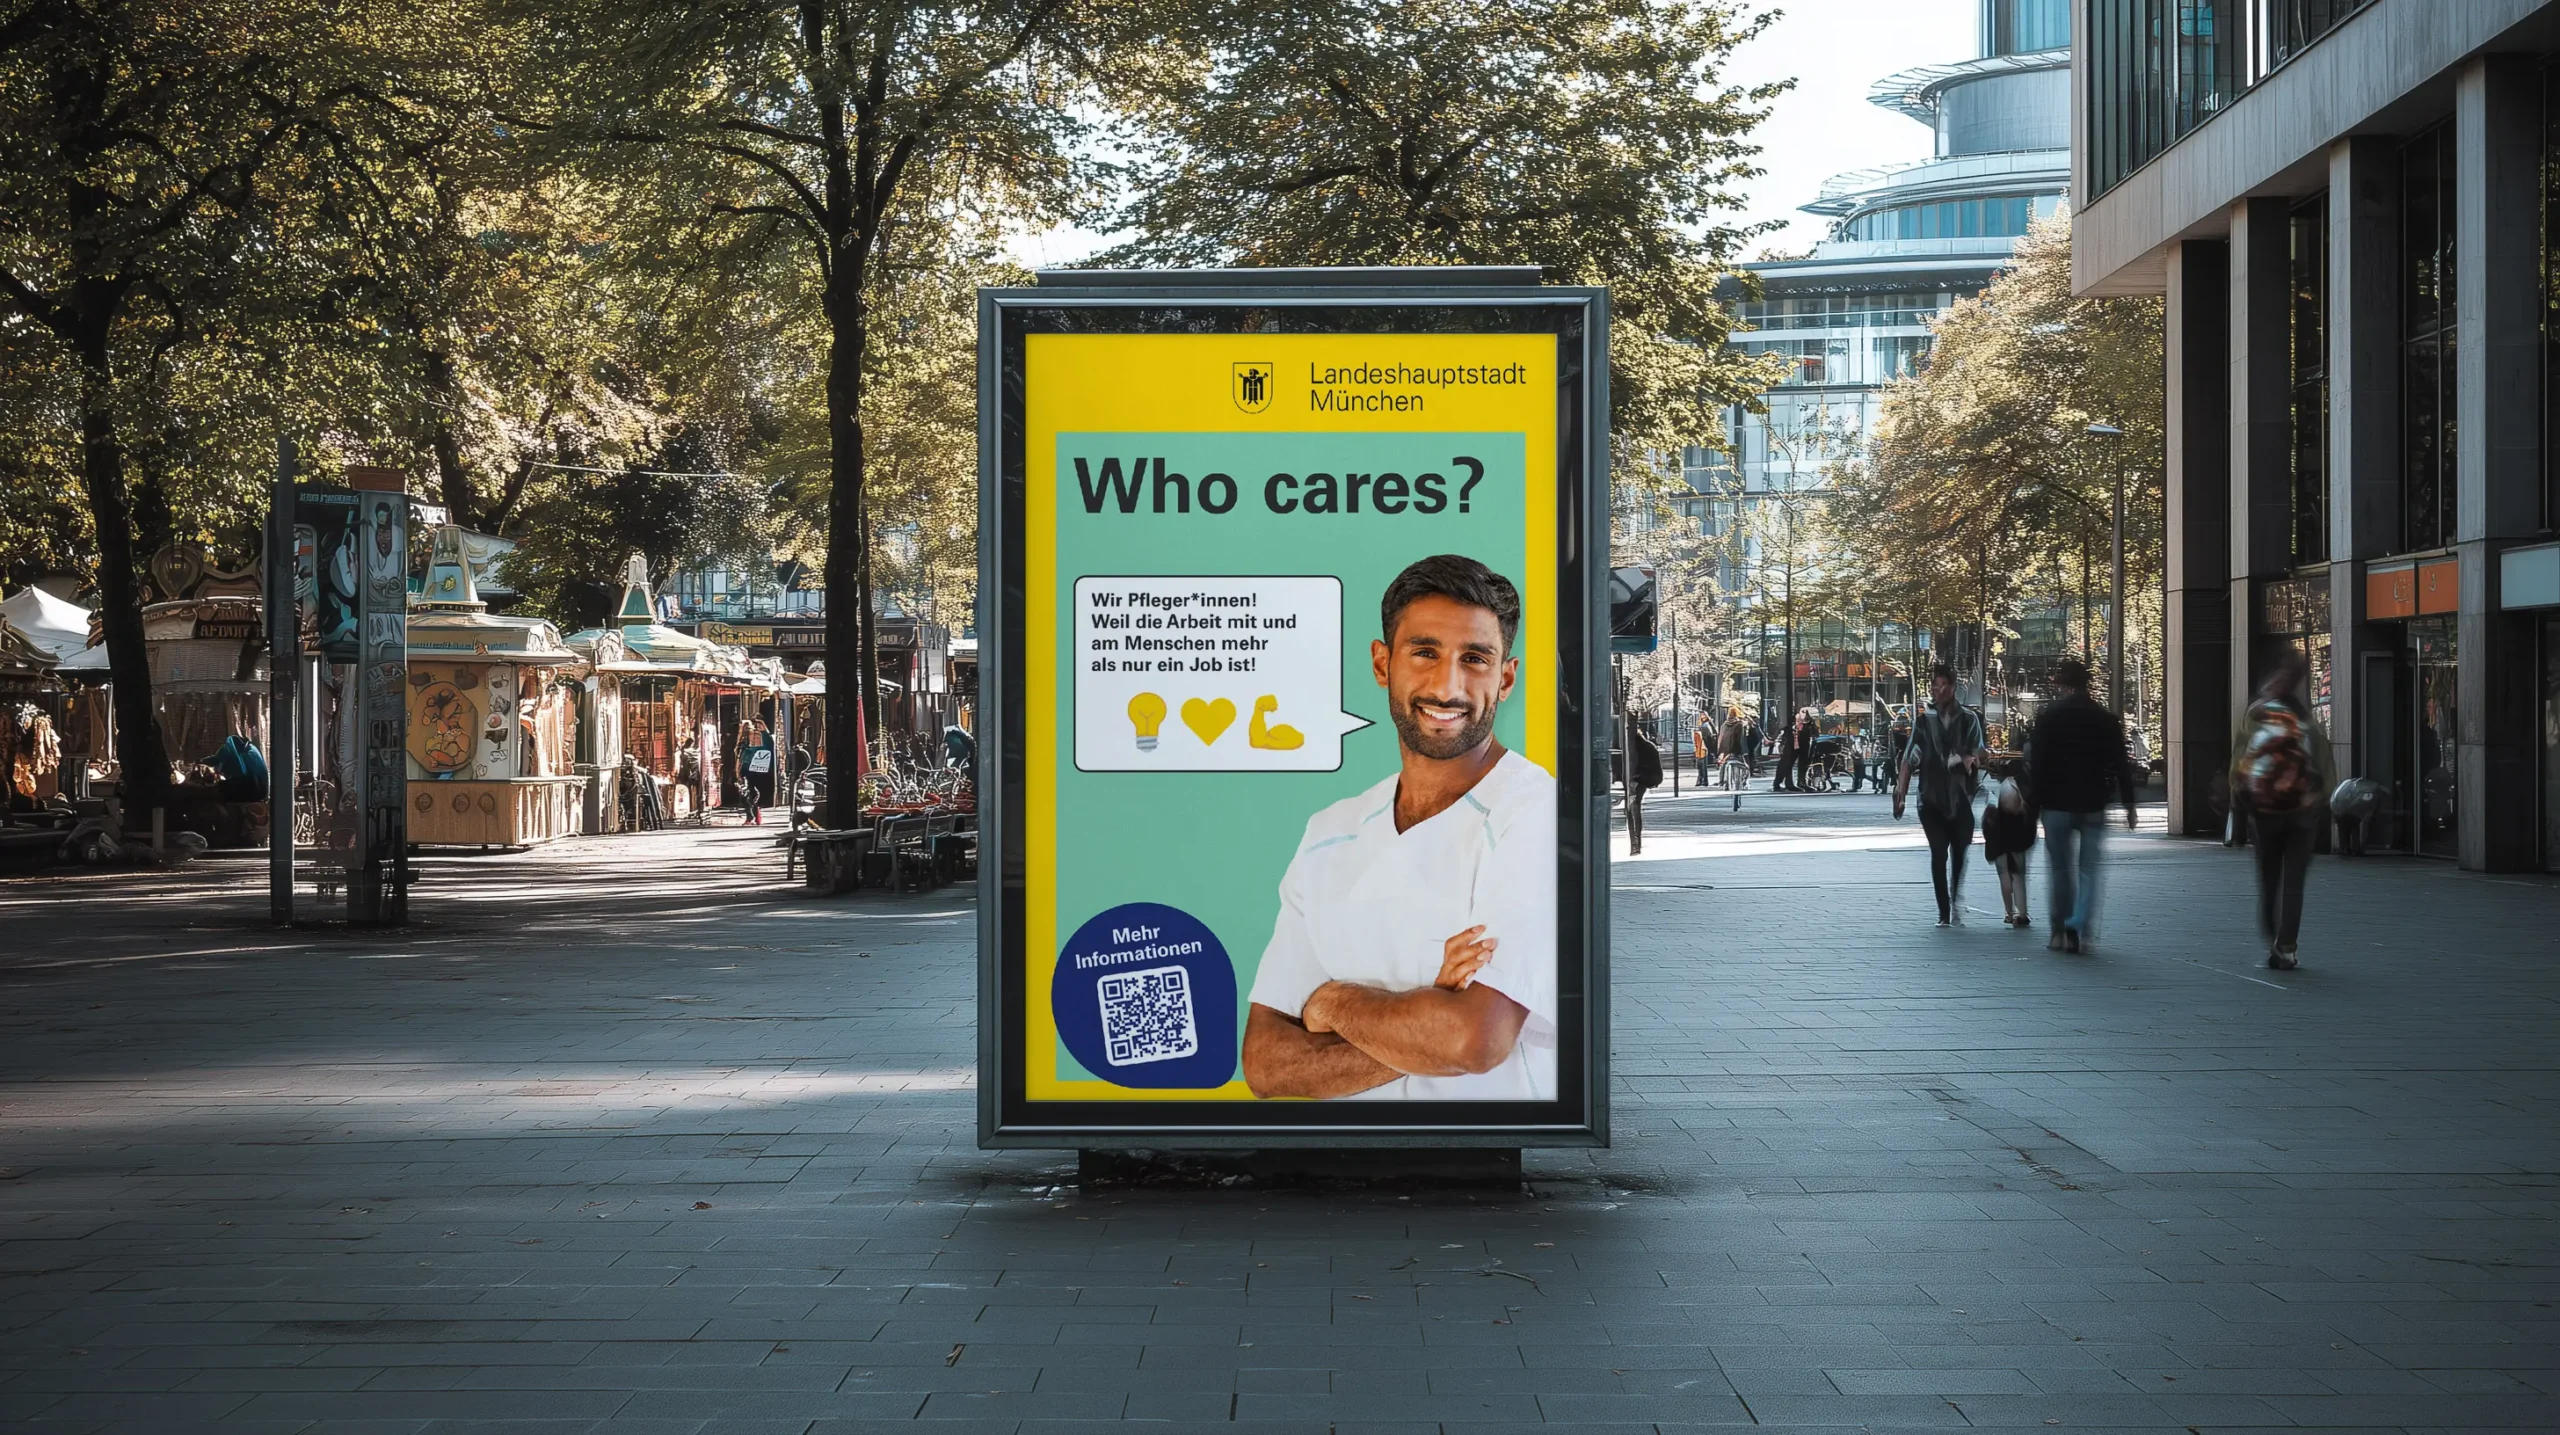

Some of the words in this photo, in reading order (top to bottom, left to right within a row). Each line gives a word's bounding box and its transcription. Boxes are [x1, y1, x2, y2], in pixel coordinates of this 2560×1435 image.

[1311, 362, 1526, 389] Landeshauptstadt
[1311, 389, 1424, 412] München
[1073, 457, 1238, 515] Who
[1264, 456, 1485, 515] cares?
[1091, 593, 1122, 608] Wir
[1091, 613, 1130, 629] Weil
[1135, 613, 1163, 629] die
[1166, 613, 1222, 629] Arbeit
[1227, 613, 1258, 629] mit
[1263, 613, 1297, 629] und
[1091, 639, 1119, 651] am
[1125, 635, 1216, 651] Menschen
[1221, 635, 1269, 651] mehr
[1091, 657, 1117, 672] als
[1122, 660, 1152, 672] nur
[1157, 657, 1184, 672] ein
[1189, 657, 1223, 672] Job
[1228, 657, 1256, 672] ist!
[1112, 925, 1161, 945] Mehr
[1075, 940, 1203, 969] Informationen
